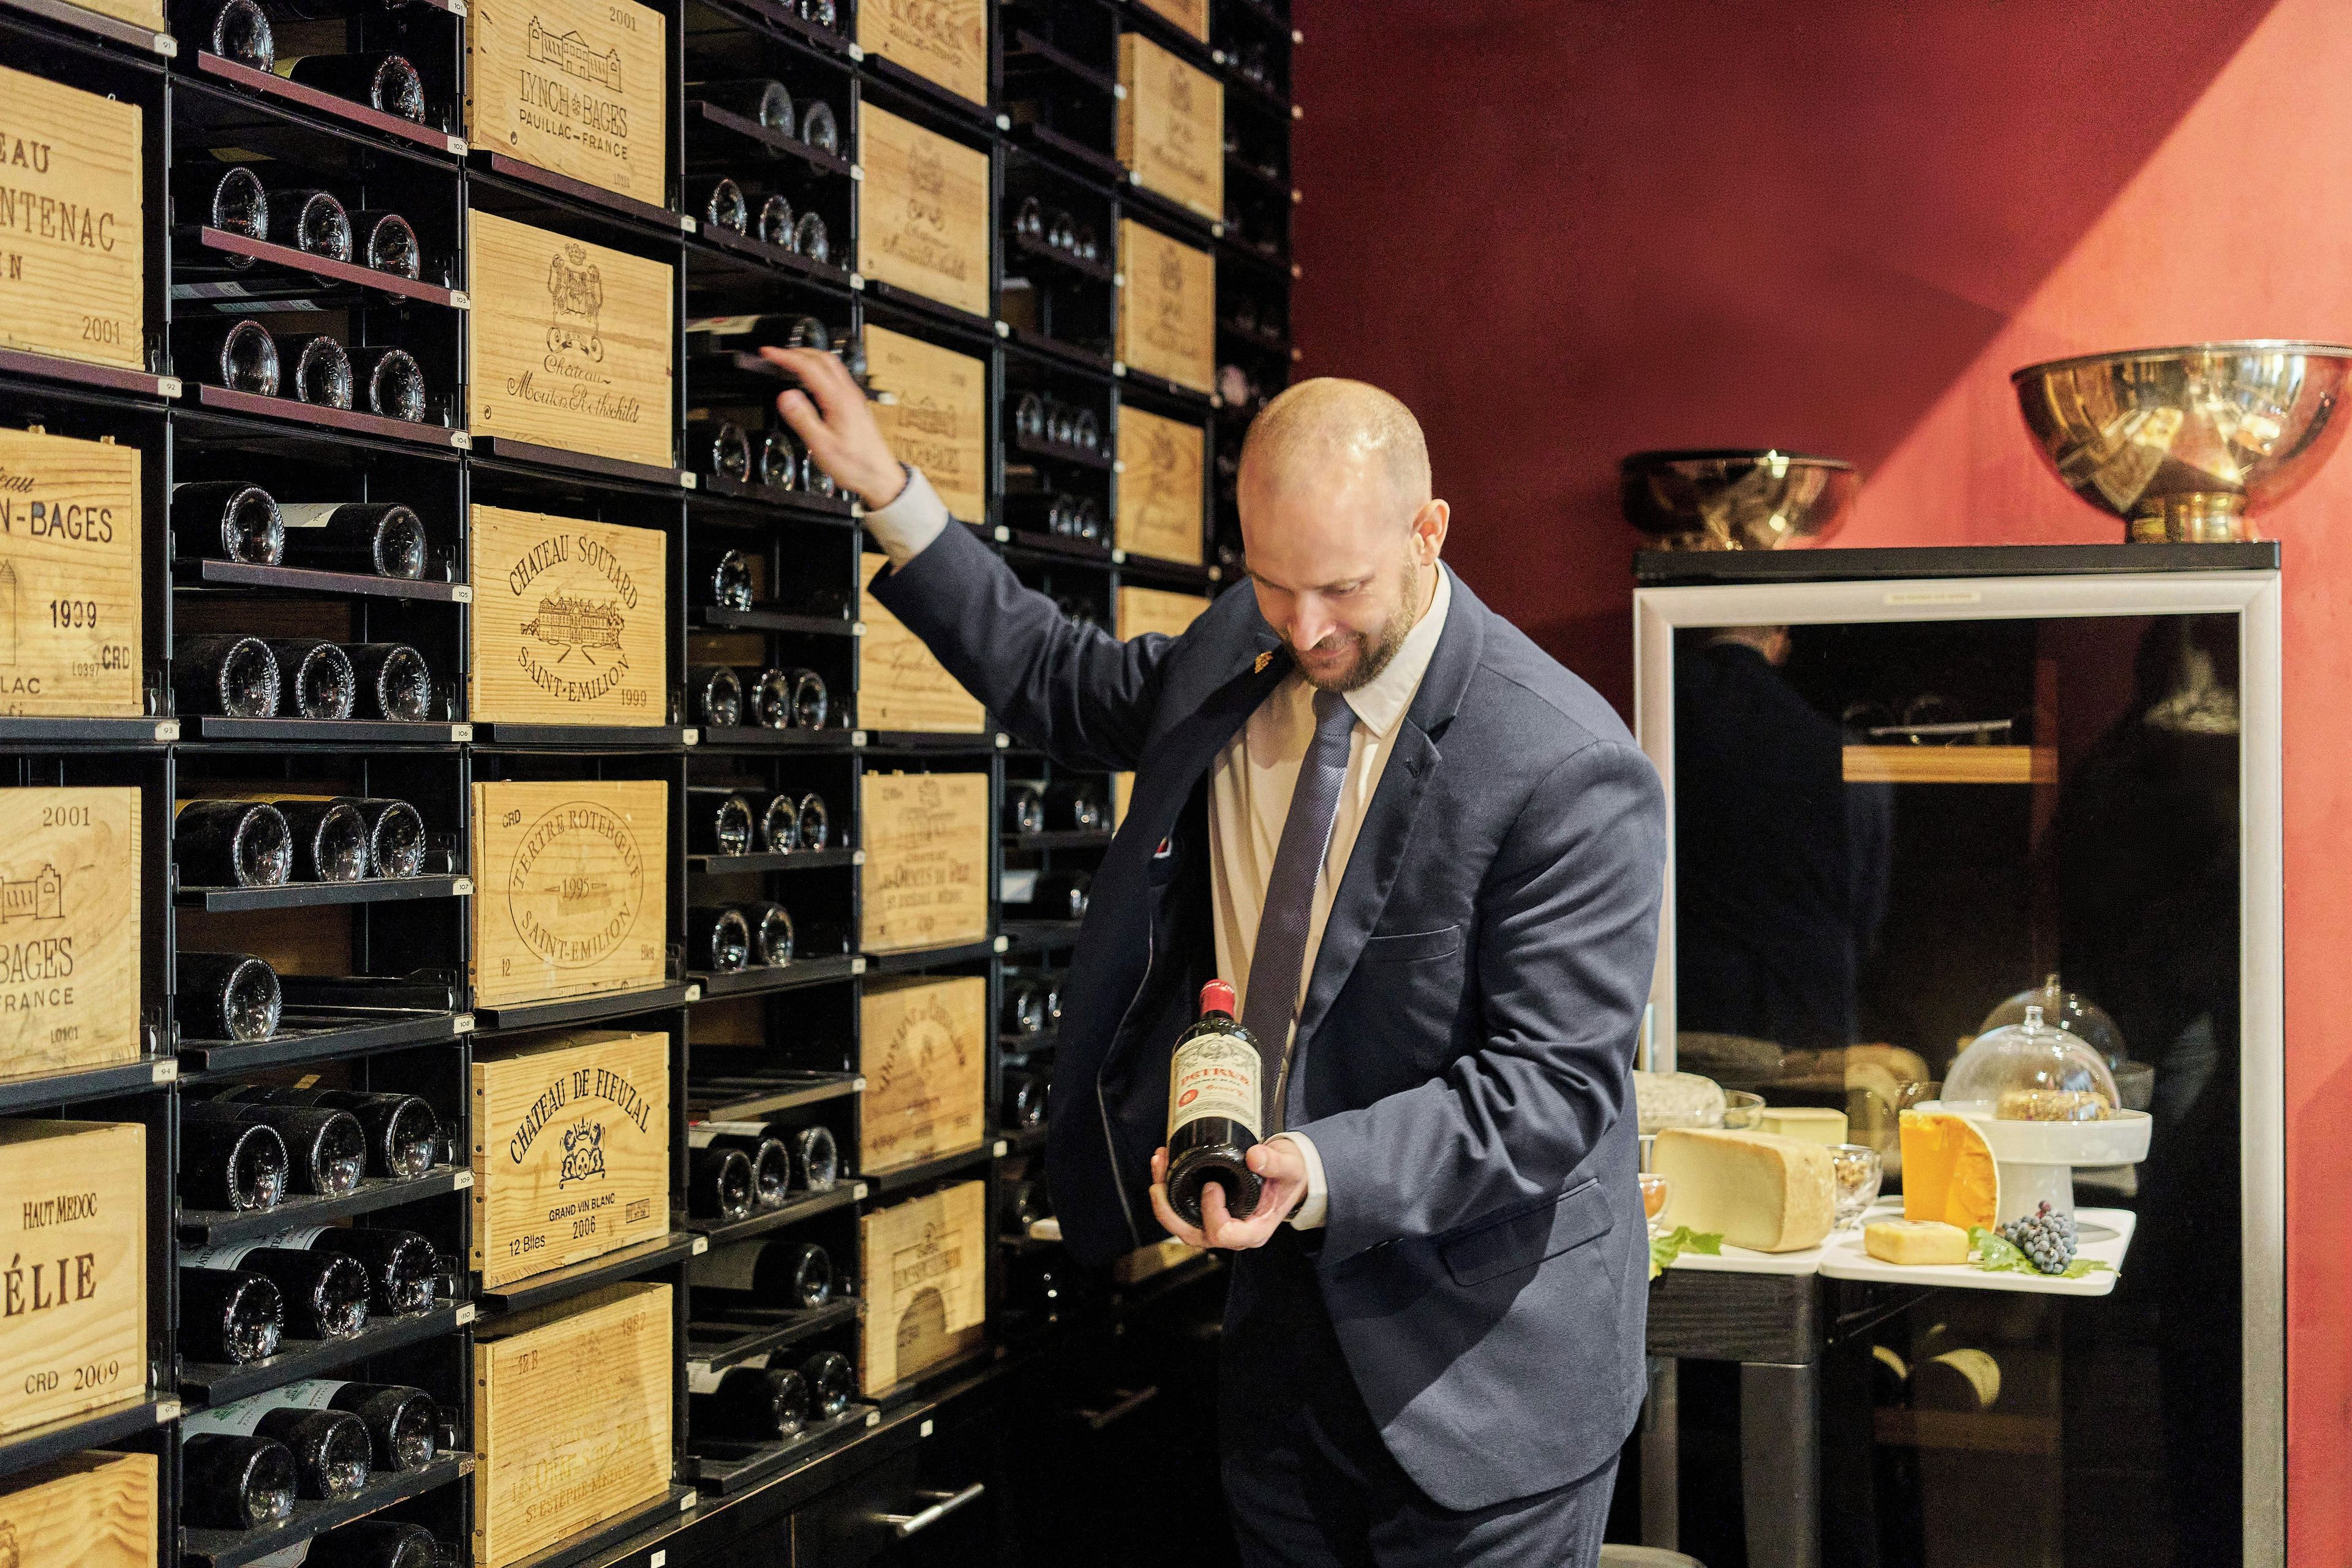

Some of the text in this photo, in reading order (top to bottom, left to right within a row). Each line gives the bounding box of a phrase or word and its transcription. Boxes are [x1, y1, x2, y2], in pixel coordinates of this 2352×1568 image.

[609, 6, 636, 31] 2001
[520, 69, 627, 138] LYNCH BAGES
[82, 316, 120, 344] 2001
[509, 535, 638, 609] CHATEAU SOUTARD
[50, 600, 96, 628] 1999
[103, 645, 130, 670] CRD
[0, 677, 40, 694] LAC
[518, 646, 630, 702] SAINT-EMILION
[621, 688, 647, 707] 1999
[43, 806, 90, 827] 2001
[502, 809, 521, 828] CRD
[513, 813, 565, 889] TERTRE
[562, 877, 590, 900] 1995
[521, 902, 632, 962] SAINT-EMILION
[502, 959, 510, 977] 12
[0, 987, 74, 1014] RANCE
[573, 1069, 590, 1099] DE
[595, 1068, 651, 1133] FIEUZAL
[23, 1193, 97, 1230] HAUT MEDOC
[549, 1193, 615, 1222] GRAND VIN BLANC
[573, 1216, 596, 1239] 2006
[509, 1240, 521, 1257] 12
[3, 1253, 97, 1318] ÉLIE
[518, 1349, 538, 1376] 12 B
[25, 1359, 119, 1395] CRD 2009
